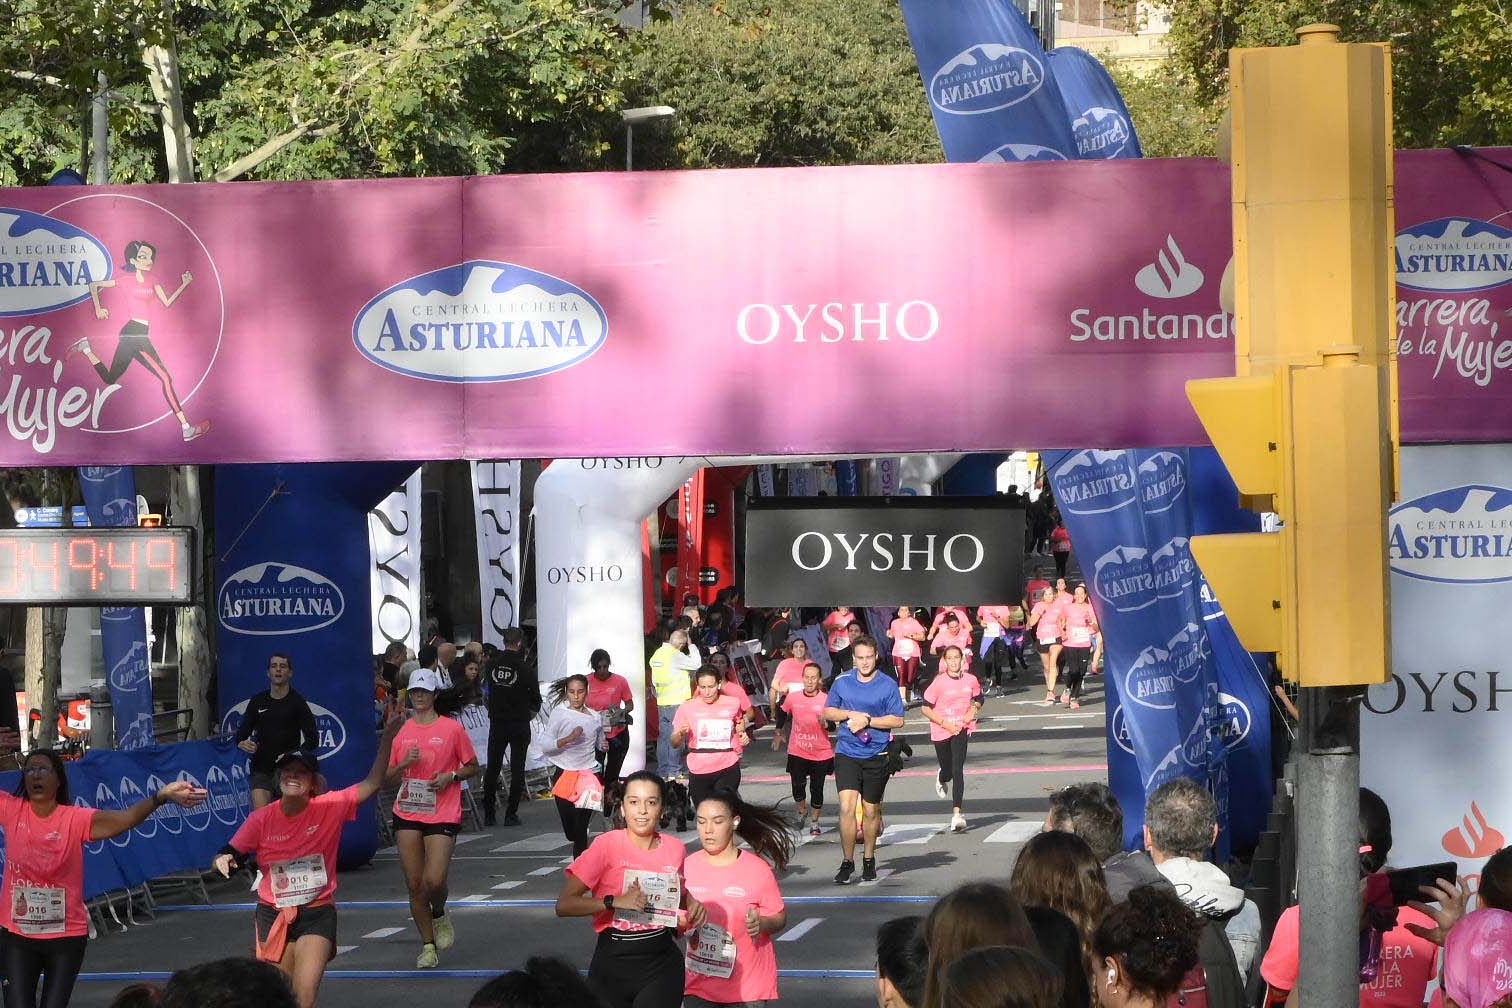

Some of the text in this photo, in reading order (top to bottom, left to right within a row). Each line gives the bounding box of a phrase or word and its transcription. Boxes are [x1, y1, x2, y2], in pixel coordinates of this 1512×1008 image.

[14, 244, 88, 256] LECHERA
[1409, 241, 1511, 251] CENTRAL LECHER
[412, 300, 580, 317] CENTRAL LECHERA
[1396, 298, 1491, 327] arrera
[372, 307, 588, 353] ASTURIANA
[737, 300, 941, 346] OYSHO
[1070, 307, 1237, 341] Santand
[1419, 327, 1437, 355] la
[1433, 322, 1512, 387] Muje
[1416, 519, 1481, 530] CENTRAL
[790, 531, 985, 574] OYSHO
[546, 564, 623, 584] OYSHO
[234, 586, 332, 596] CENTRAL LECHERA
[222, 589, 336, 619] ASTURIANA
[497, 670, 511, 680] BP
[289, 875, 309, 885] 016
[29, 906, 47, 914] 016
[1383, 961, 1400, 974] LA
